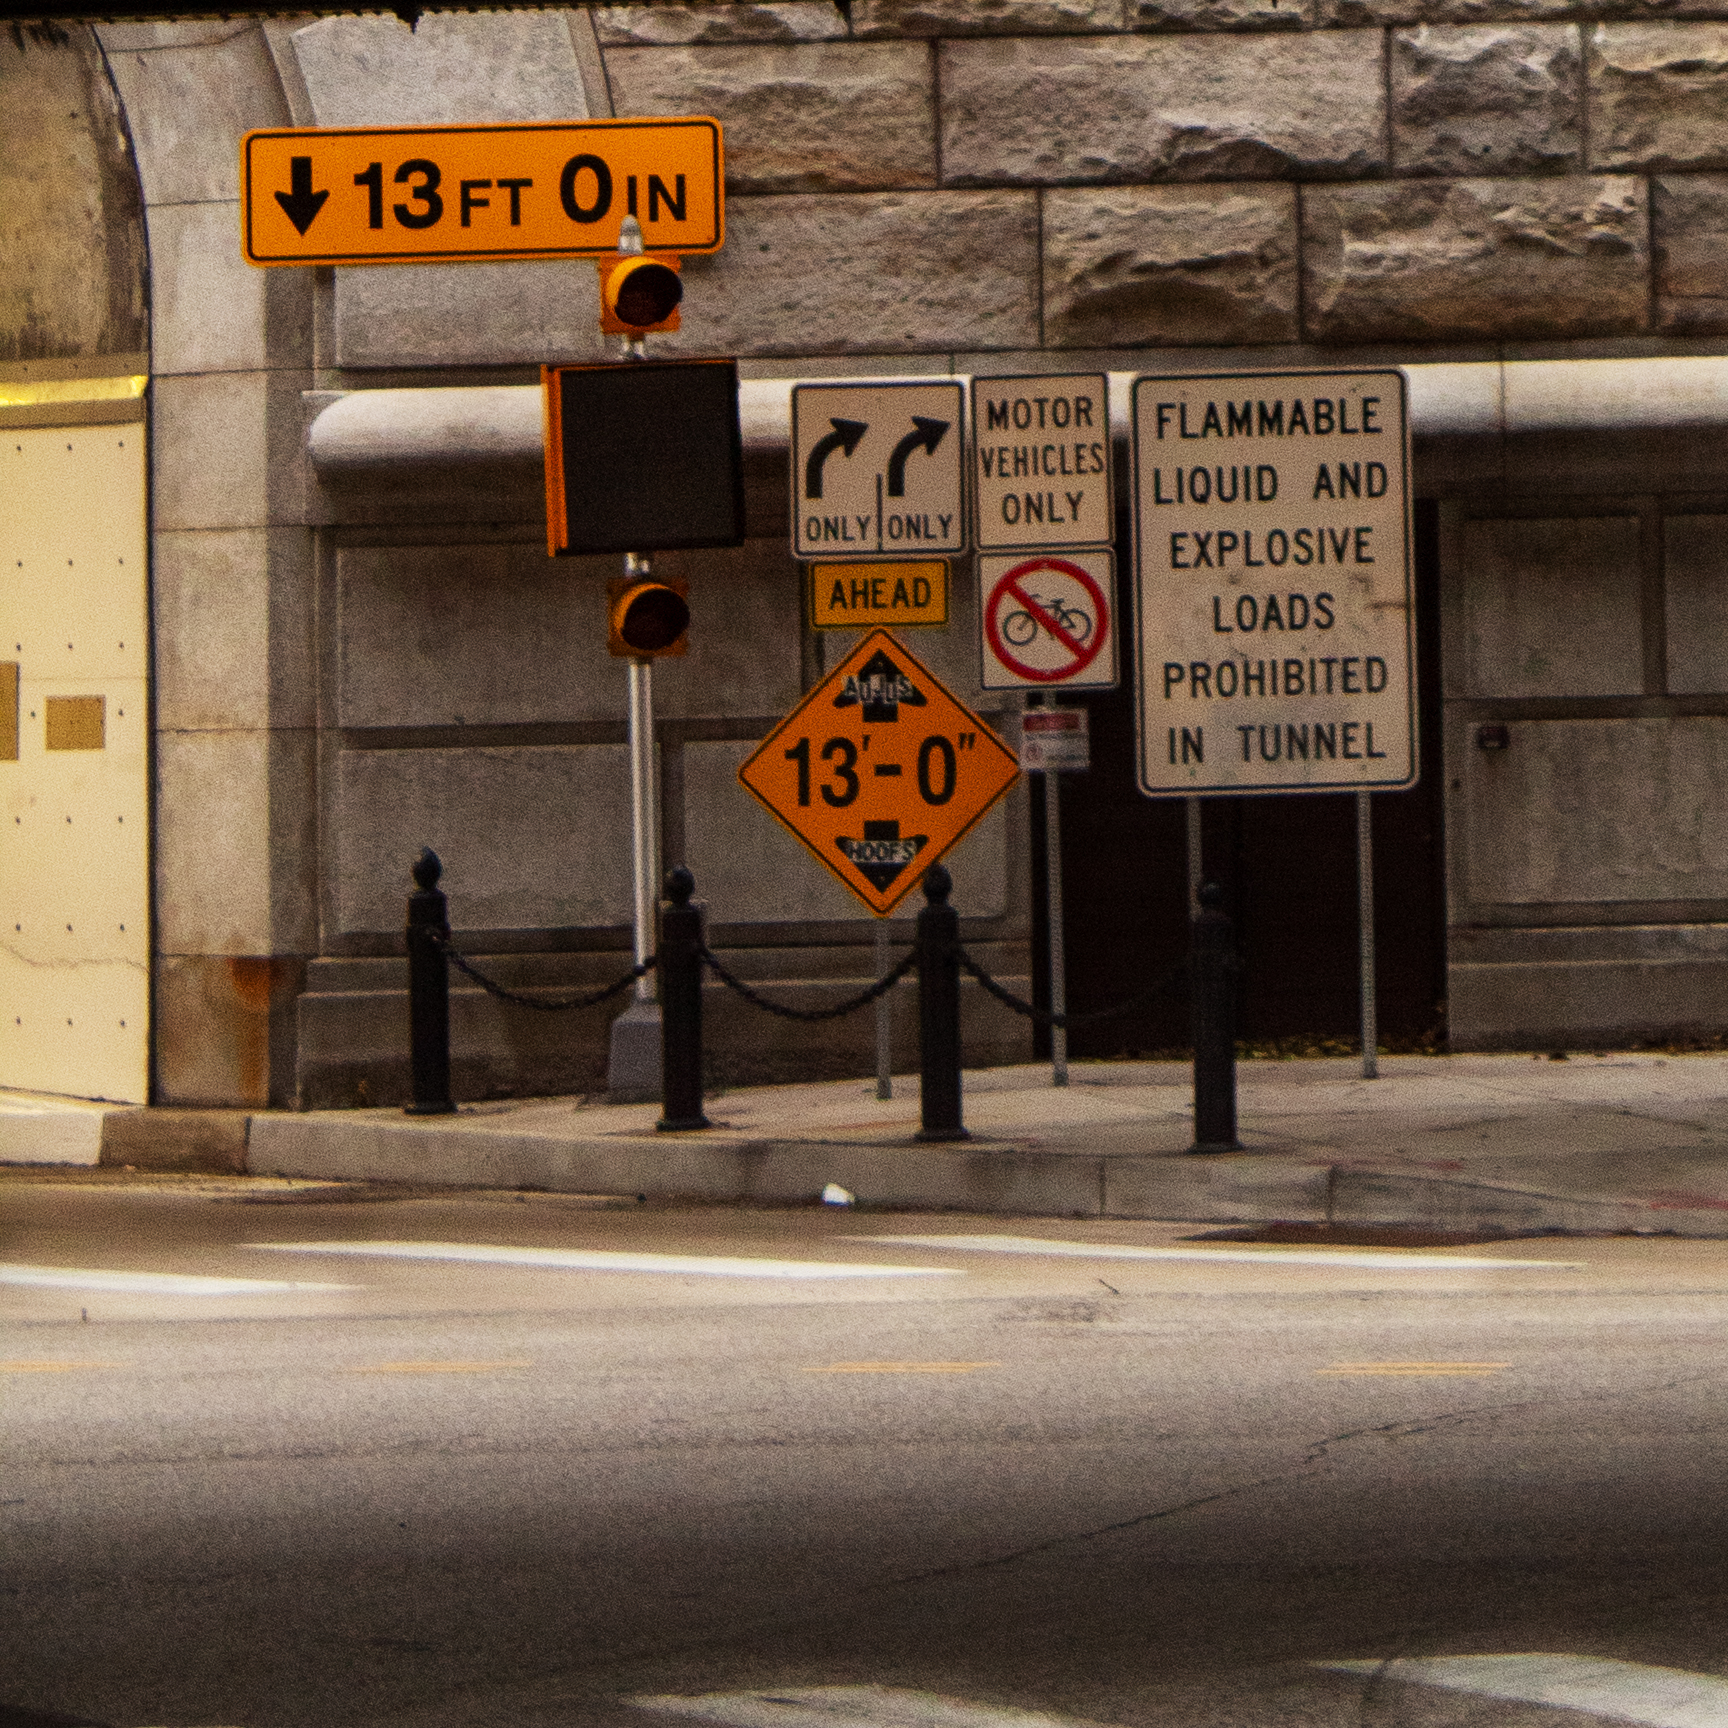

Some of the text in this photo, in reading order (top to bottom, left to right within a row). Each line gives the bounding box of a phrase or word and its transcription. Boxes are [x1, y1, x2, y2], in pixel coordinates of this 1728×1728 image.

[986, 395, 1094, 433] MOTOR
[1155, 396, 1383, 440] FLAMMABLE
[979, 442, 1105, 479] VEHICLES
[1153, 460, 1389, 506] LIQUID AND
[805, 514, 872, 542] ONLY
[887, 512, 953, 541] ONLY
[1001, 490, 1085, 526] ONLY
[1169, 526, 1376, 570] EXPLOSIVE
[828, 577, 932, 611] AHEAD
[1212, 591, 1336, 634] LOADS
[1163, 655, 1388, 700] PROHIBITED
[1167, 720, 1387, 765] IN TUNNEL
